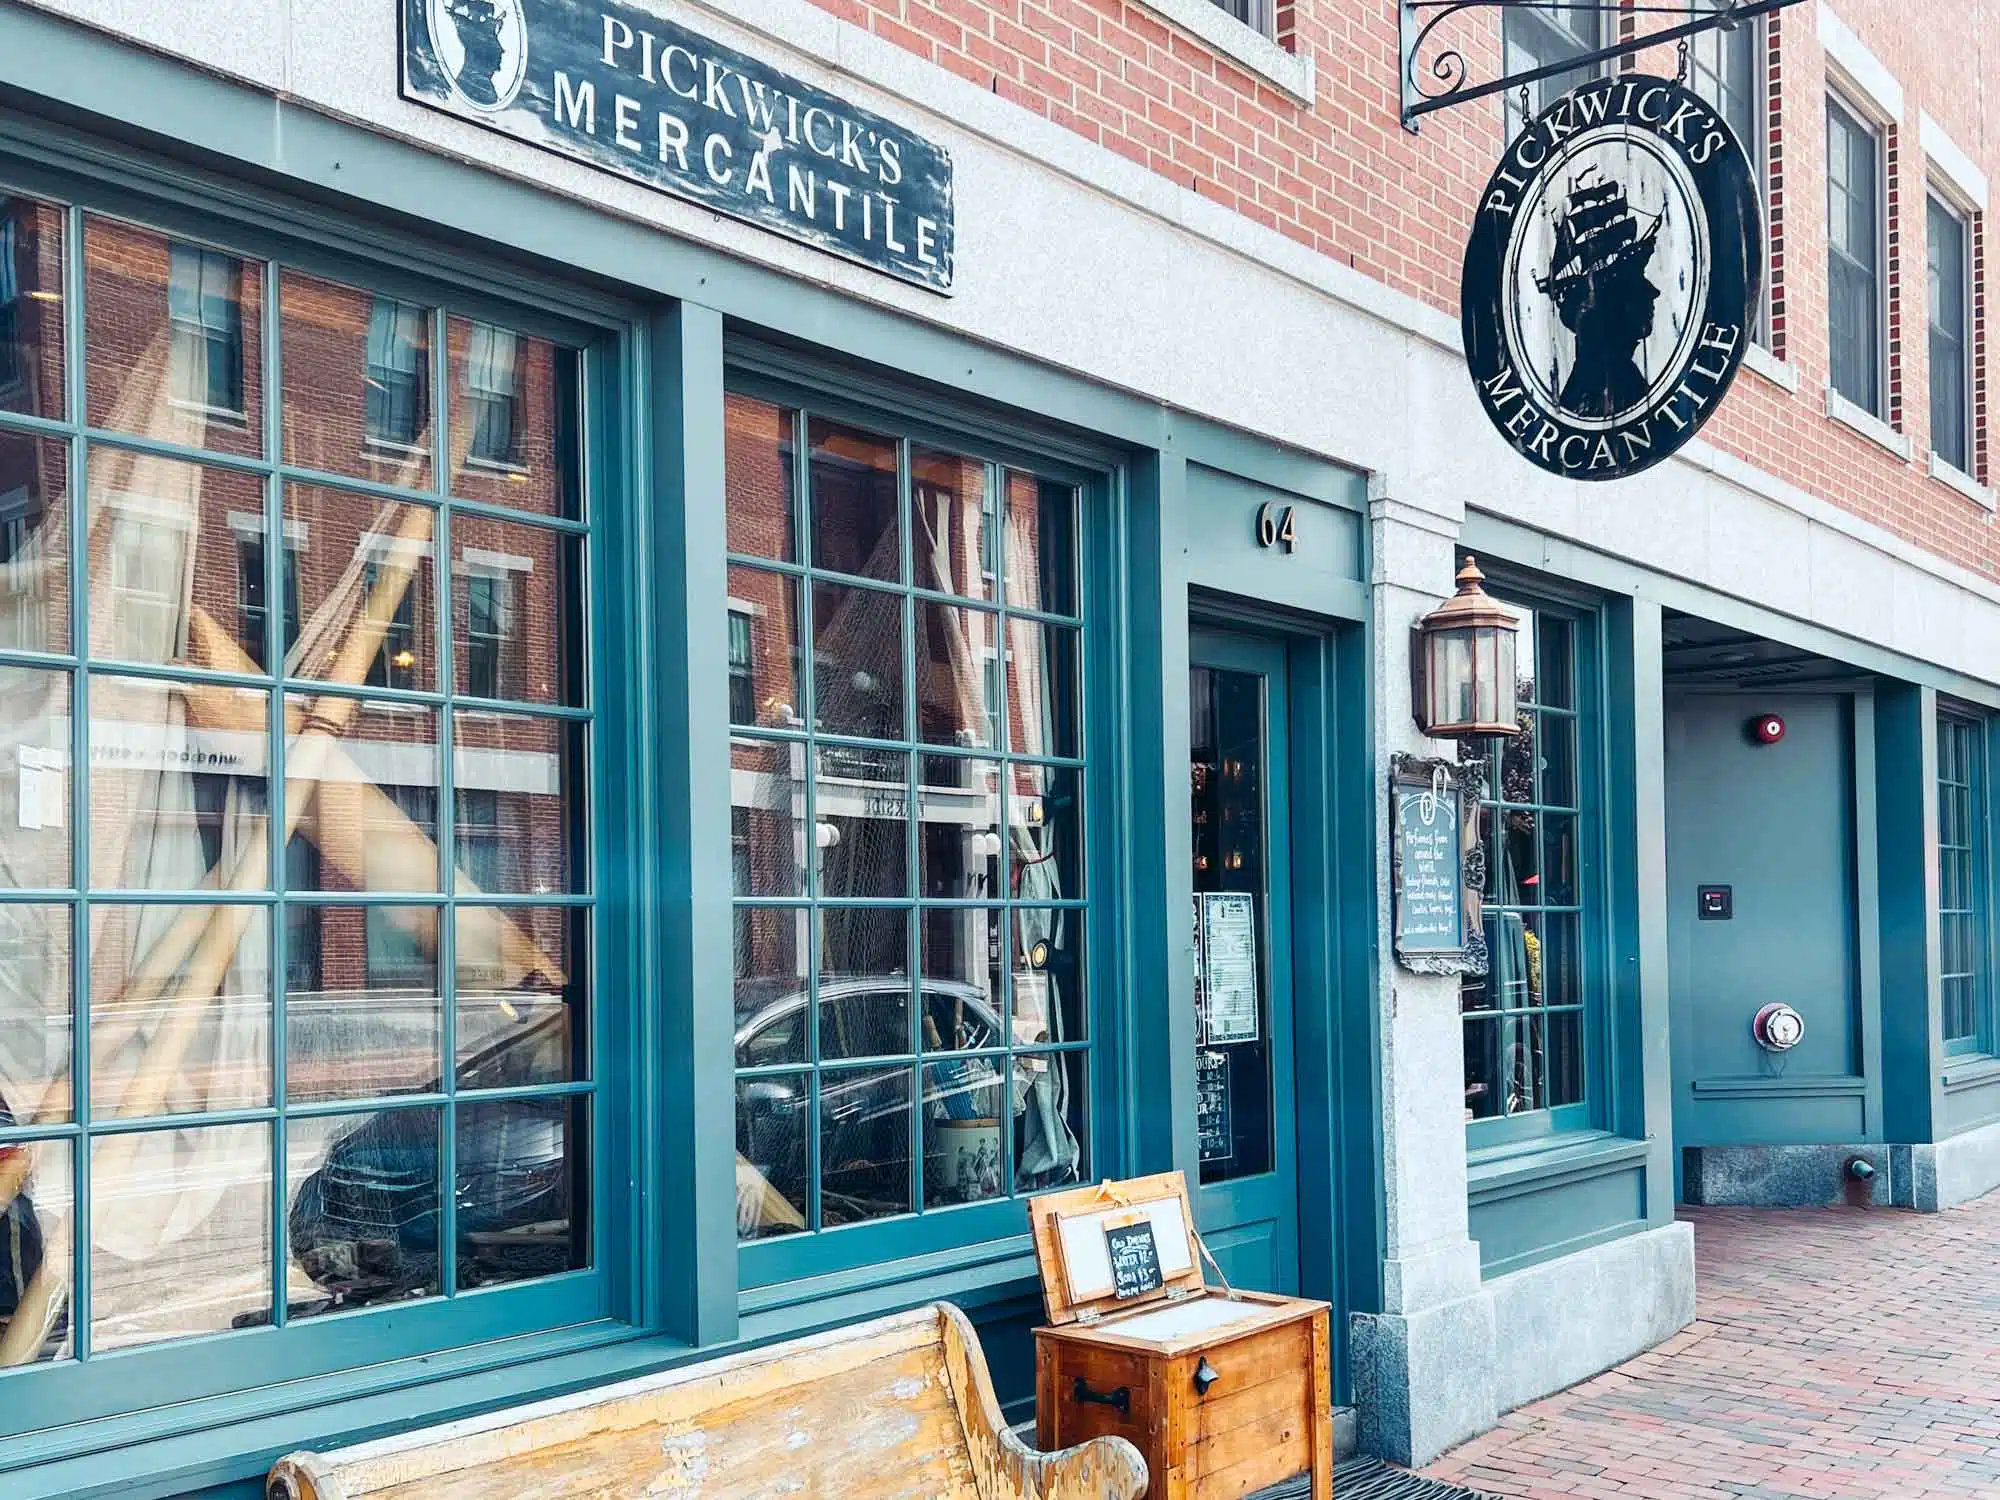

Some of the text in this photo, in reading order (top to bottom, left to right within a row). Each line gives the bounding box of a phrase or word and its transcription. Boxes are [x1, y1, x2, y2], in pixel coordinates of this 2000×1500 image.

[553, 70, 938, 265] MERCANTILE
[599, 14, 902, 188] PICKWICK'S
[1485, 82, 1728, 218] PICKWICK'S
[1482, 321, 1740, 470] MERCANTILE
[1256, 501, 1297, 554] 64
